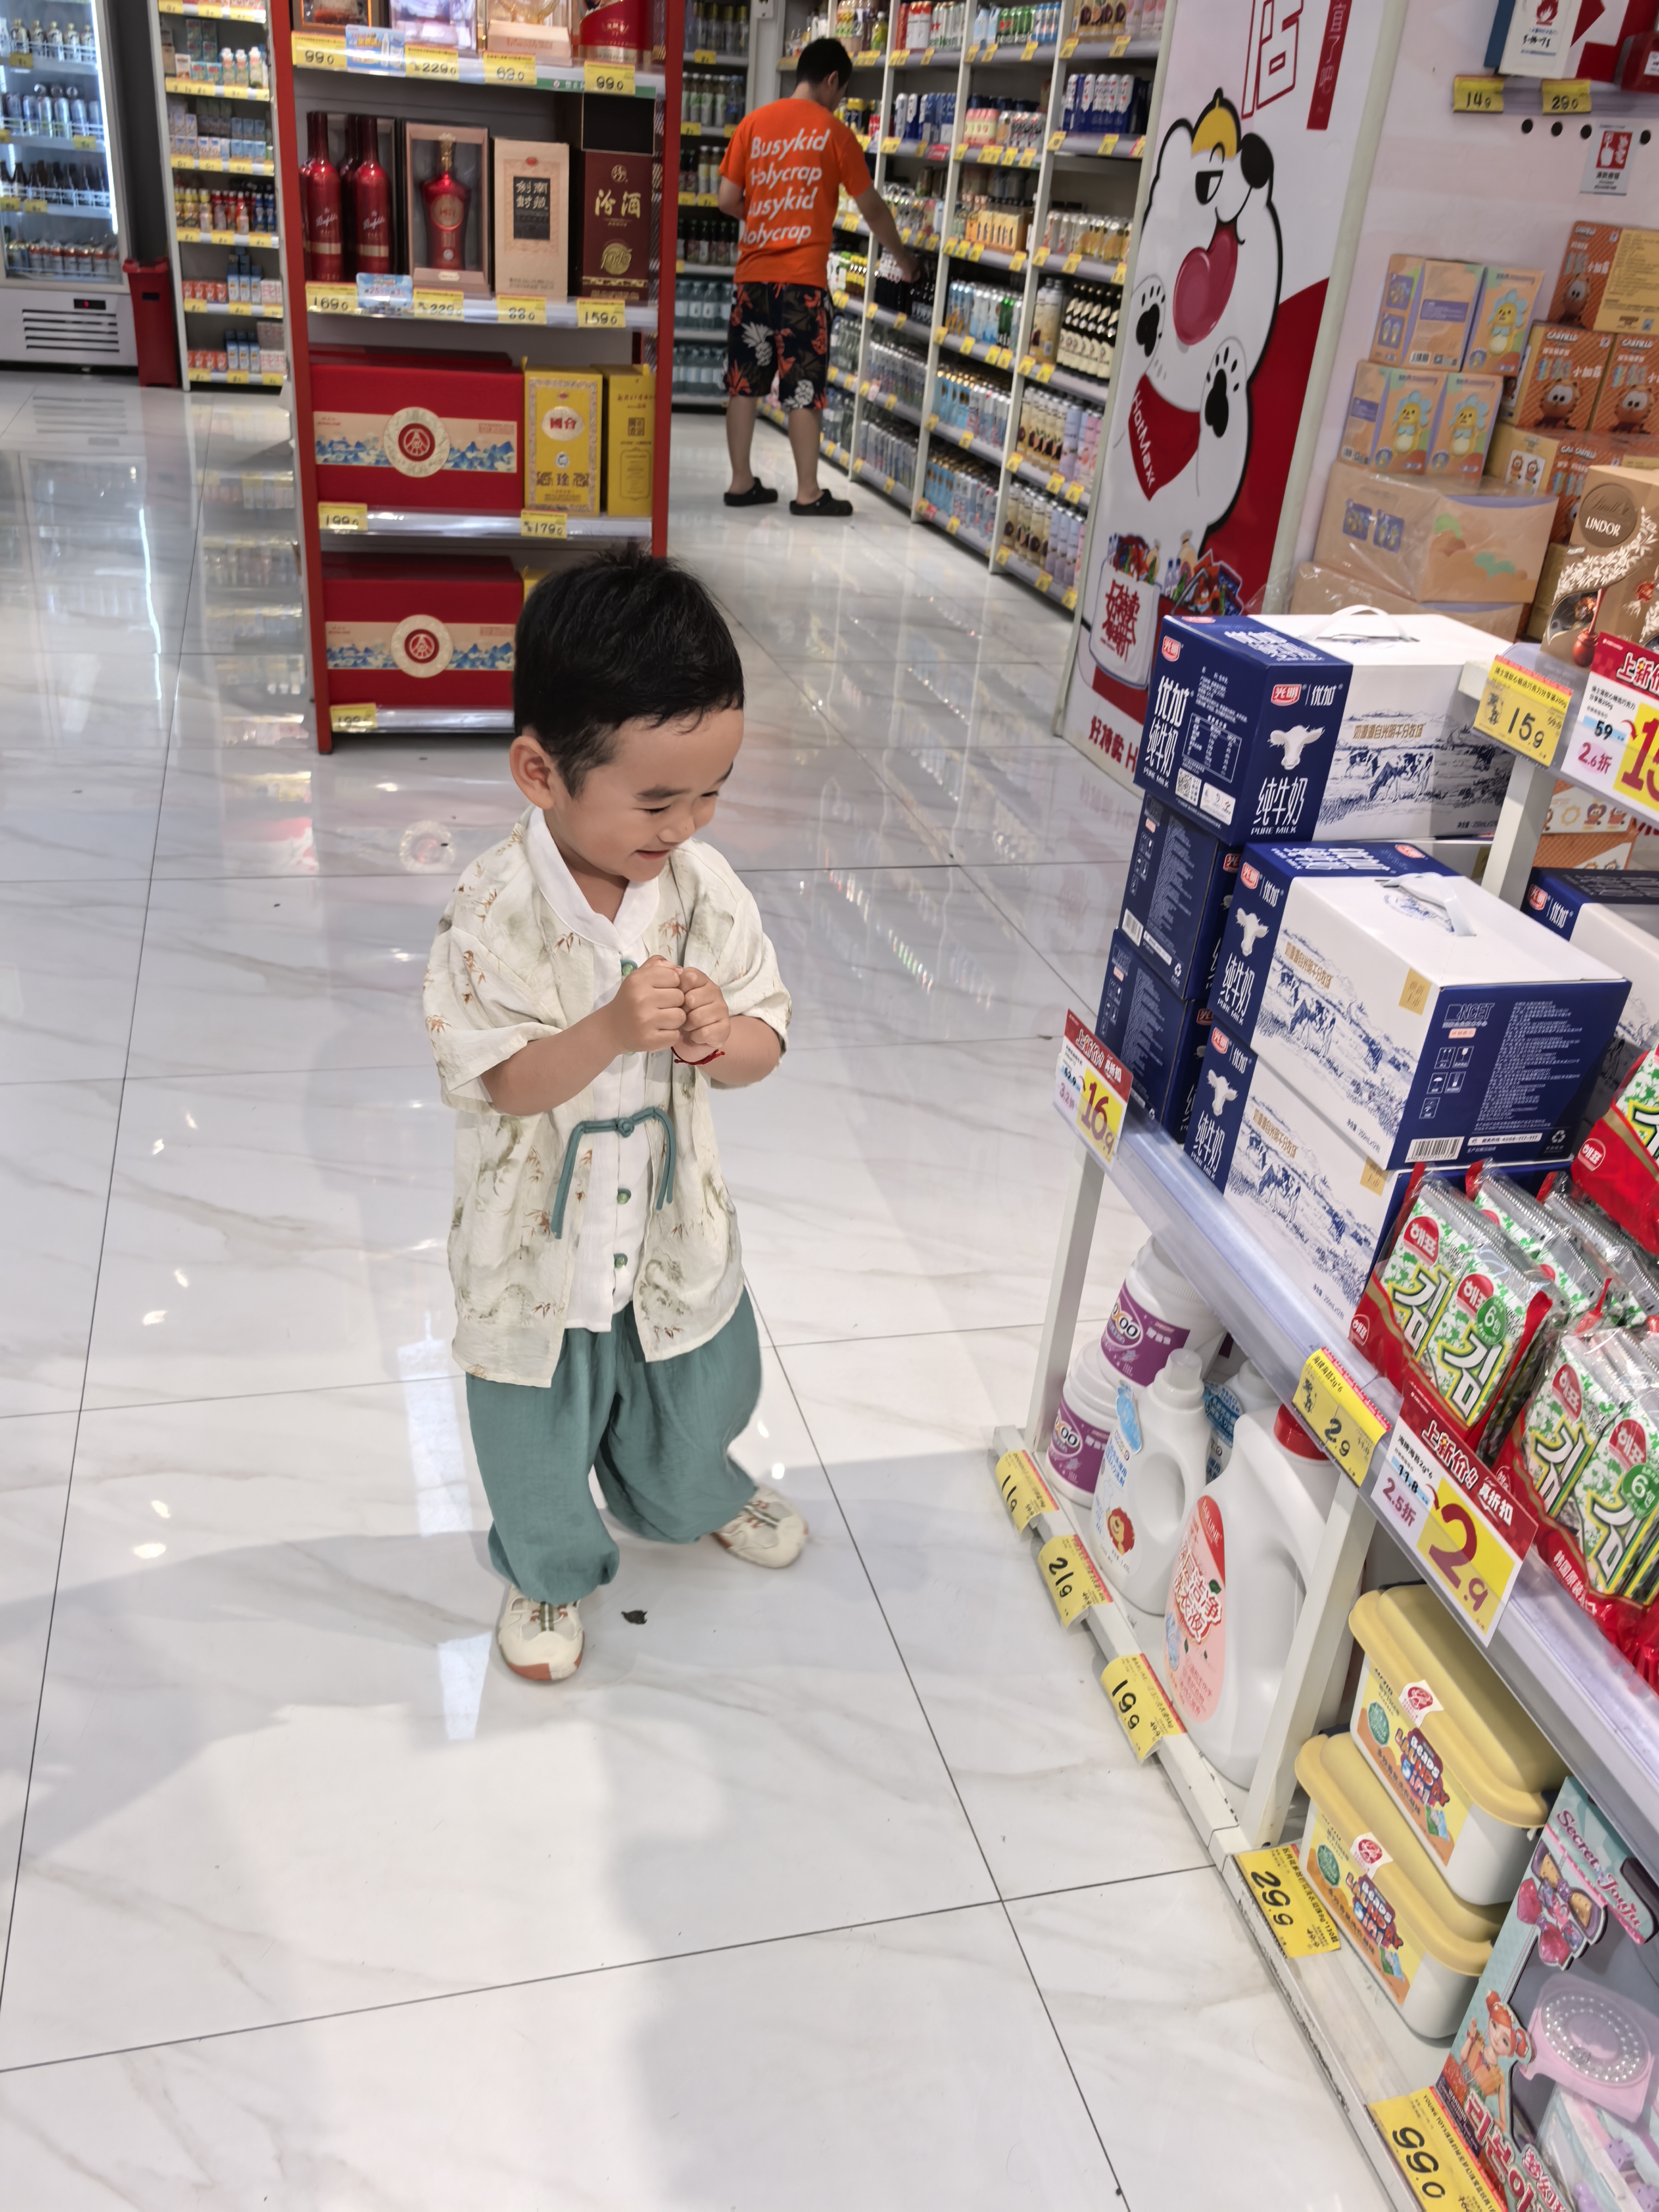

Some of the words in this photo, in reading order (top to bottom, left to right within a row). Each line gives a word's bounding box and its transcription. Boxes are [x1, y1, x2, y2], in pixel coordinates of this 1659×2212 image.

[750, 127, 831, 161] Busykid
[1584, 516, 1622, 539] LINDOR
[1273, 689, 1300, 700] 光明
[1310, 684, 1337, 707] 优加
[1144, 717, 1179, 778] 纯牛奶
[1507, 706, 1545, 749] 15.9
[1594, 720, 1614, 740] 59
[1577, 741, 1613, 775] 2.6折
[1252, 775, 1309, 826] 纯牛奶
[1250, 826, 1274, 836] PURE
[1276, 825, 1298, 835] MILK
[1243, 865, 1260, 886] 光明
[1219, 952, 1256, 1018] 纯牛奶
[1213, 1030, 1229, 1051] 光明
[1081, 1081, 1115, 1155] 16.9
[1193, 1110, 1226, 1174] 纯牛奶
[1581, 1143, 1603, 1165] 해표
[1408, 1222, 1437, 1258] 해표
[1351, 1317, 1370, 1339] 해표
[1393, 1269, 1452, 1352] 김
[1443, 1331, 1503, 1419] 김
[1557, 1371, 1580, 1413] 해표
[1323, 1417, 1351, 1458] 2.9
[1617, 1426, 1645, 1465] 해표
[1397, 1464, 1420, 1494] 11.8
[1382, 1475, 1418, 1528] 2.5折
[1427, 1502, 1489, 1613] 2.9
[1556, 1809, 1600, 1871] Secret
[1251, 1869, 1294, 1927] 29.9
[1392, 2126, 1446, 2200] 99.0
